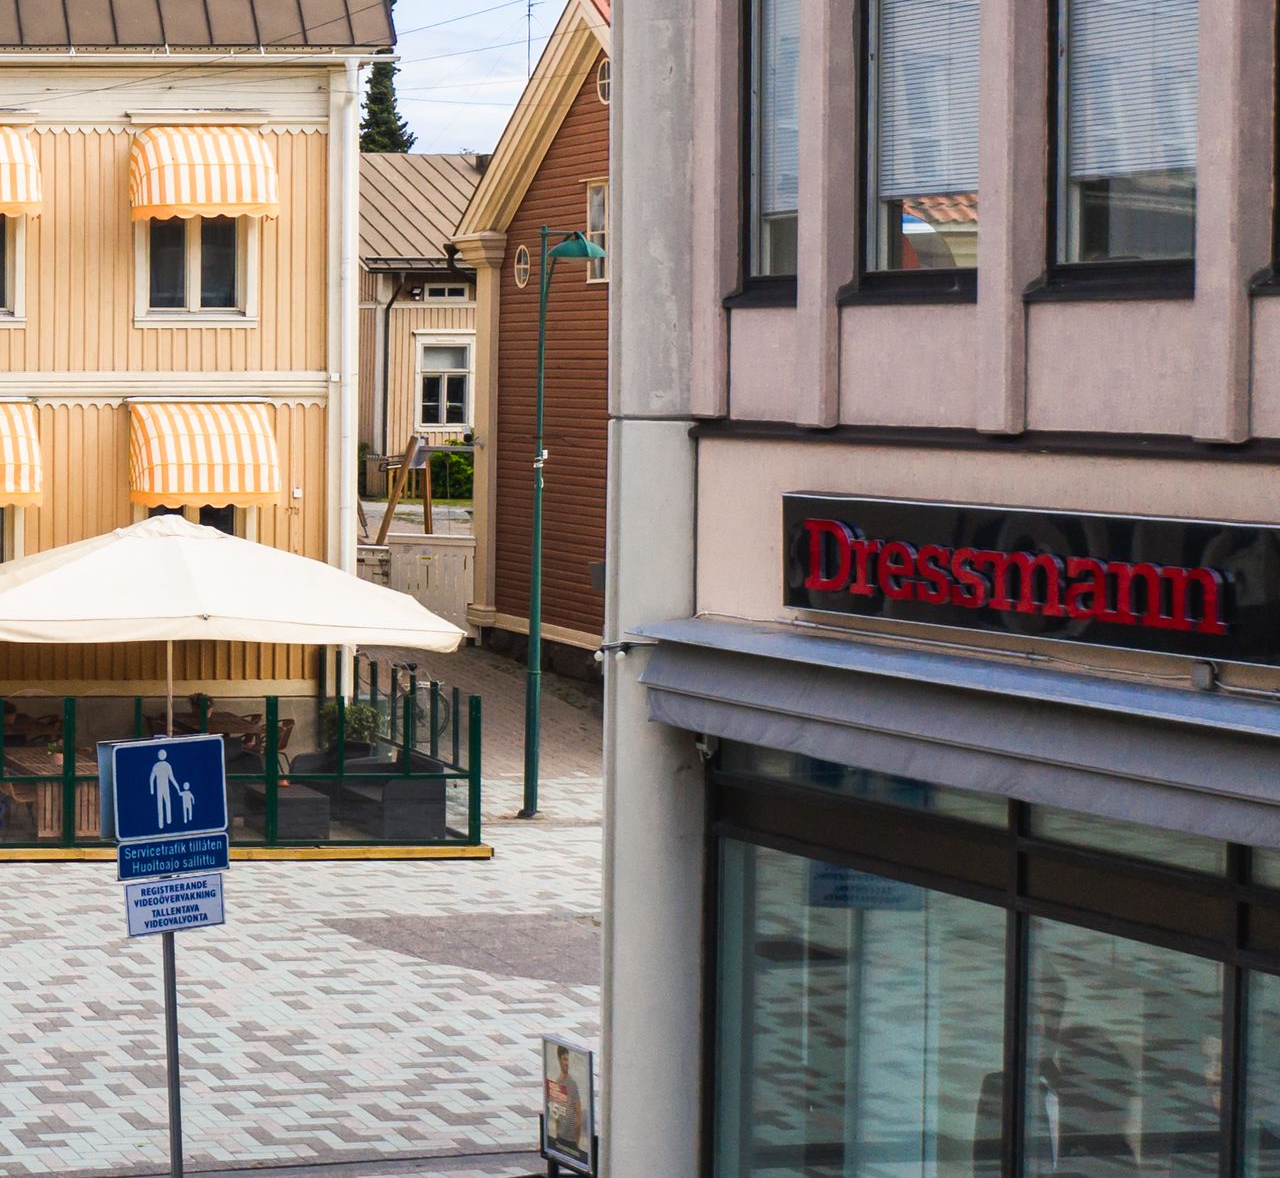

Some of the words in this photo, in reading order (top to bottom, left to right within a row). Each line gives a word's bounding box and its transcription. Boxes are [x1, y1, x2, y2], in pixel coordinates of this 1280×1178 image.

[802, 517, 1230, 636] Dressmann
[124, 842, 187, 860] Servicetrafik
[189, 839, 223, 853] tillåten
[132, 858, 180, 874] Huoltoajo
[182, 854, 216, 868] sallittu
[140, 879, 208, 897] REGISTRERANDE
[133, 889, 217, 908] VIDEOÖVERVAKNING
[151, 903, 200, 918] TALLENTAVA
[144, 912, 209, 929] VIDEOVALVONTA
